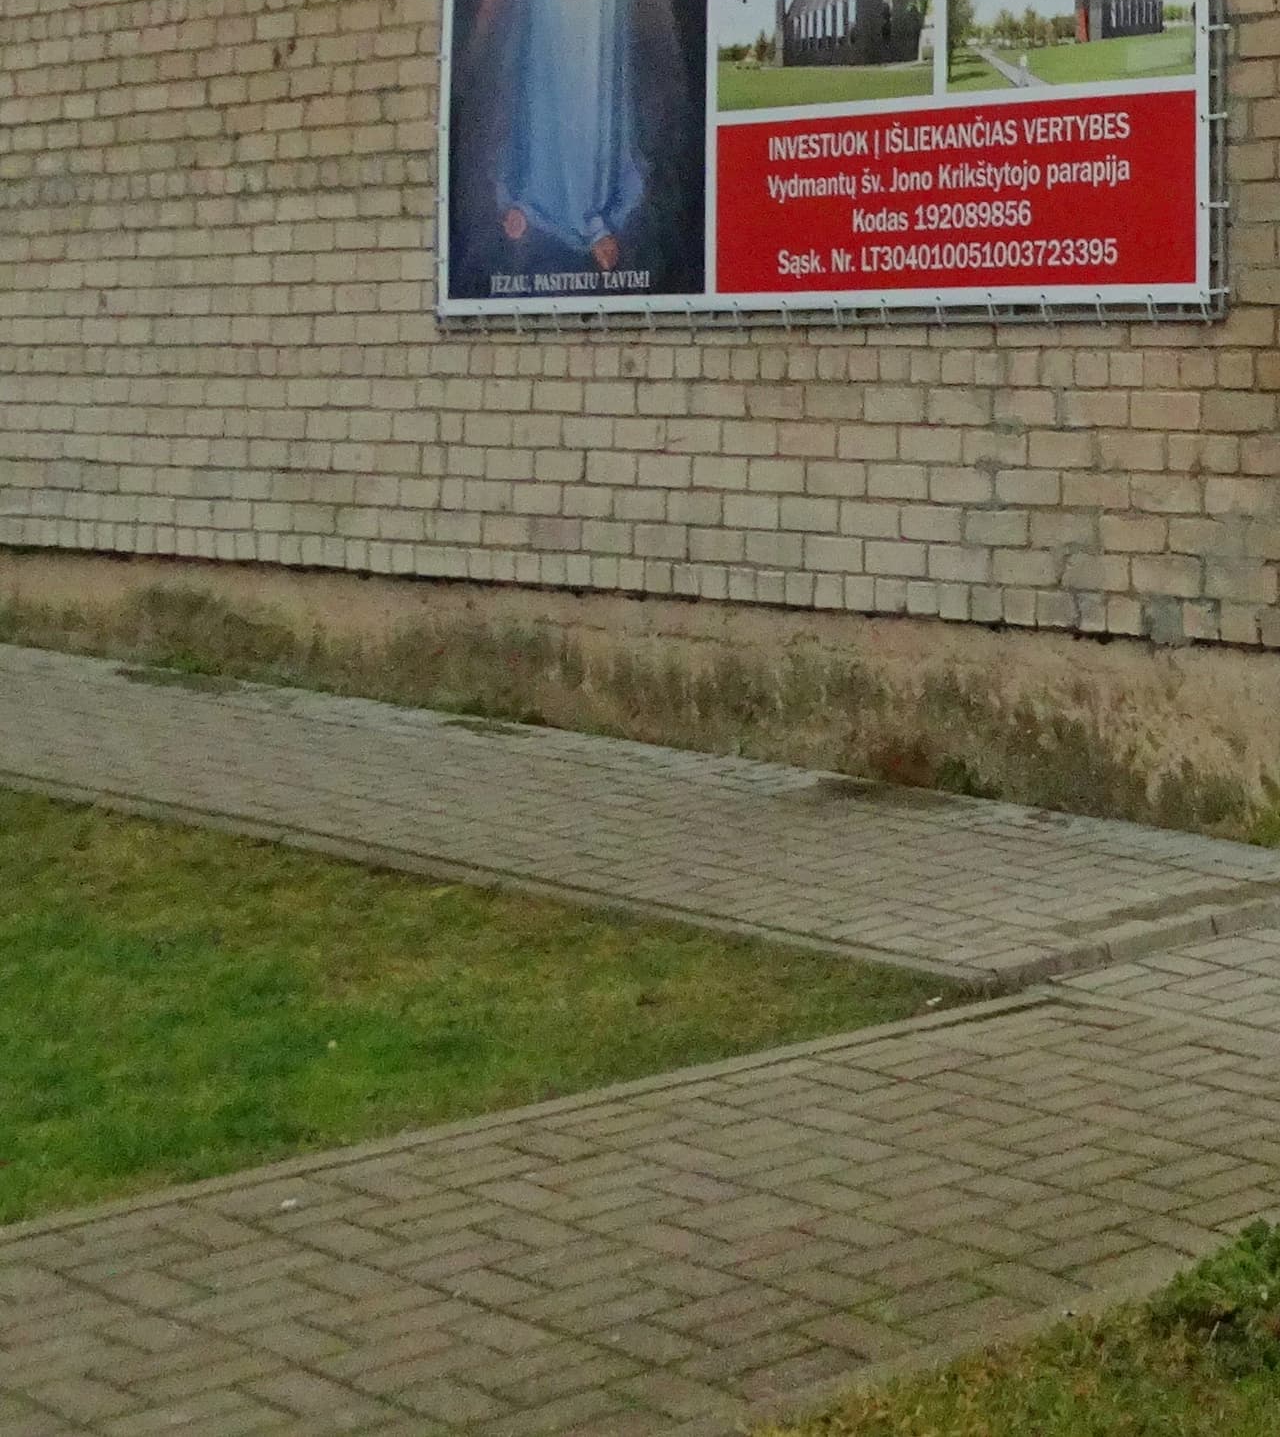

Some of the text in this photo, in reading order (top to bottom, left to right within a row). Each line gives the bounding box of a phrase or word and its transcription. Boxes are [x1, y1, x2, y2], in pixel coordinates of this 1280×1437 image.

[768, 112, 1130, 160] INVESTUOK Į IŠLIEKANČIAS VERTYBES
[767, 156, 1130, 203] Vydmantų šv. Jono Krikštytojo parapija
[852, 200, 1031, 232] Kodas 192089856
[778, 238, 1118, 278] Sąsk. Nr. LT304010051003723395
